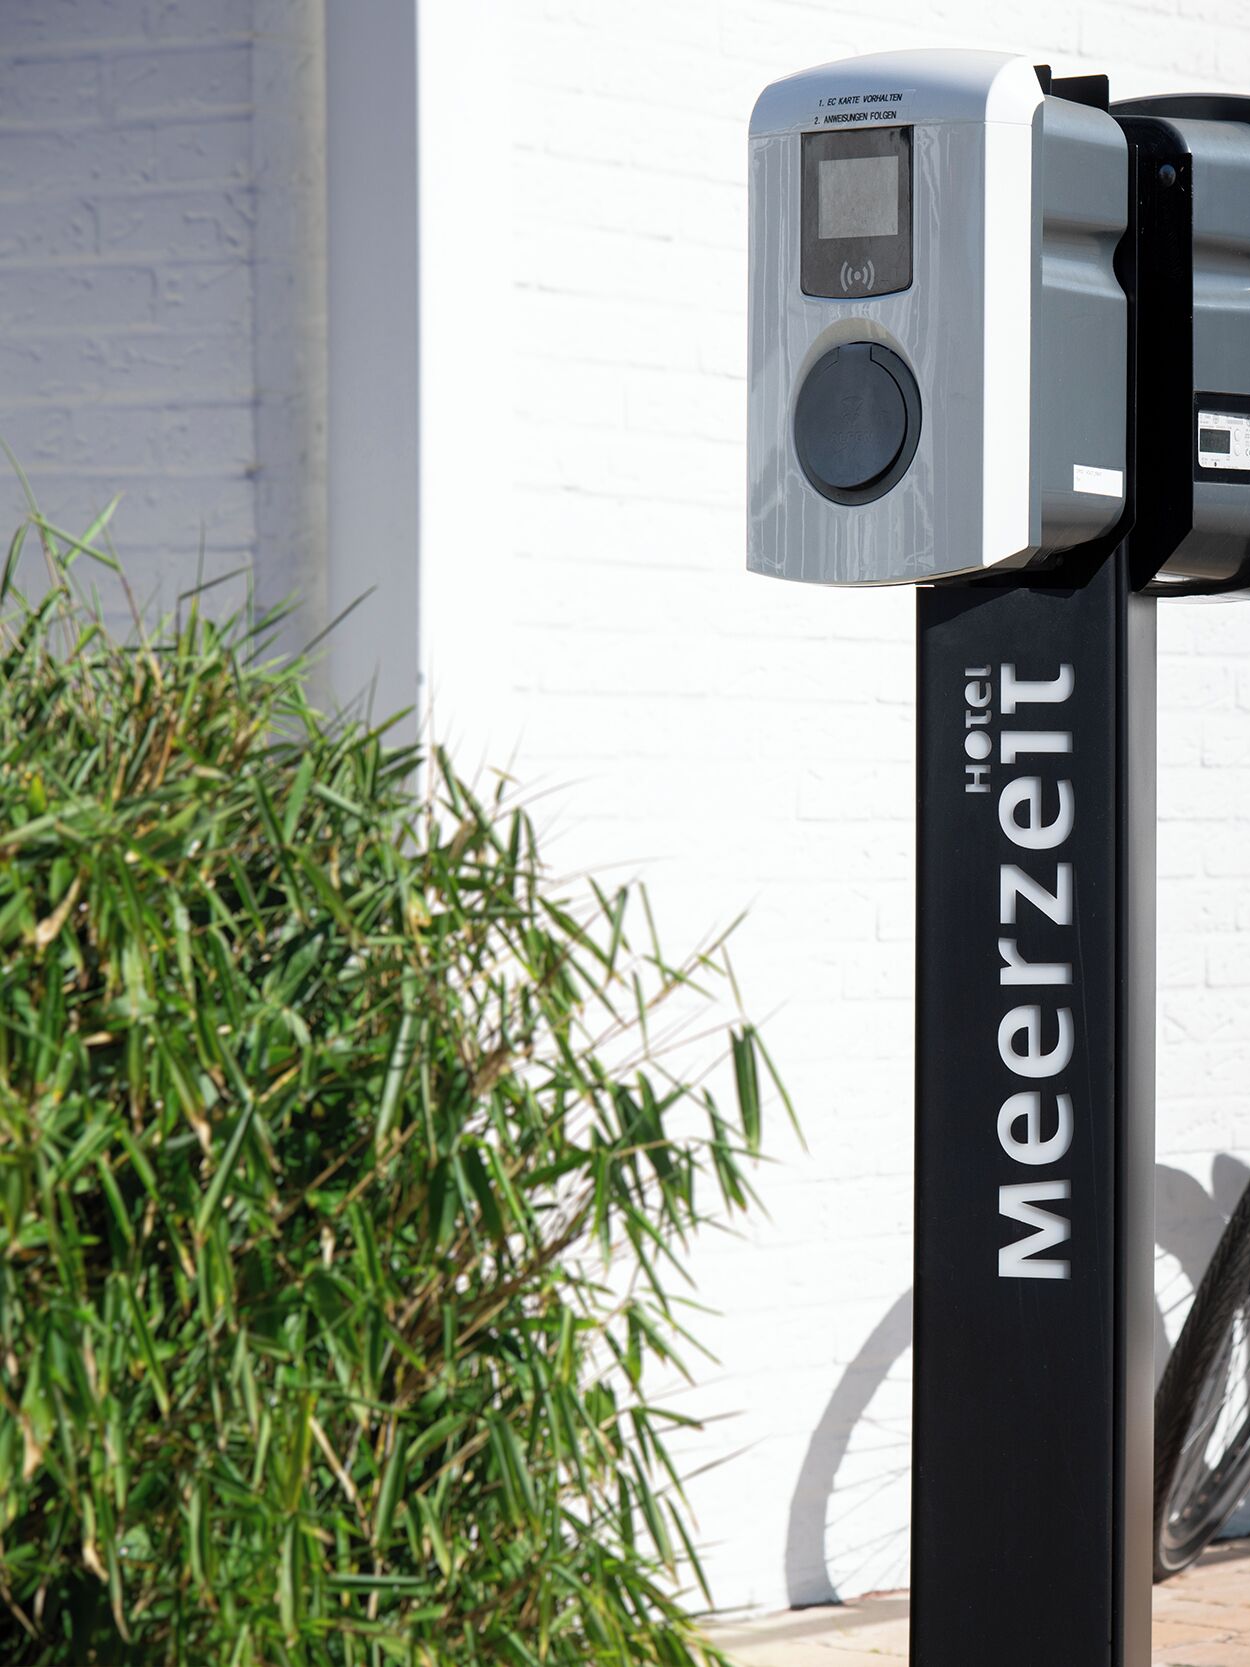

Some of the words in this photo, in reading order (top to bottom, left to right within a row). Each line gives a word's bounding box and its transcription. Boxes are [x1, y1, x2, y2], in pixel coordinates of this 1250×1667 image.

[819, 99, 825, 107] 1.
[827, 97, 837, 106] EC
[838, 95, 861, 105] KARTE
[863, 93, 903, 103] VORHALTEN
[814, 116, 821, 125] 2.
[823, 112, 868, 124] ANWEISUNGEN
[870, 110, 897, 121] FOLGEN
[997, 662, 1075, 1280] Meerzeit
